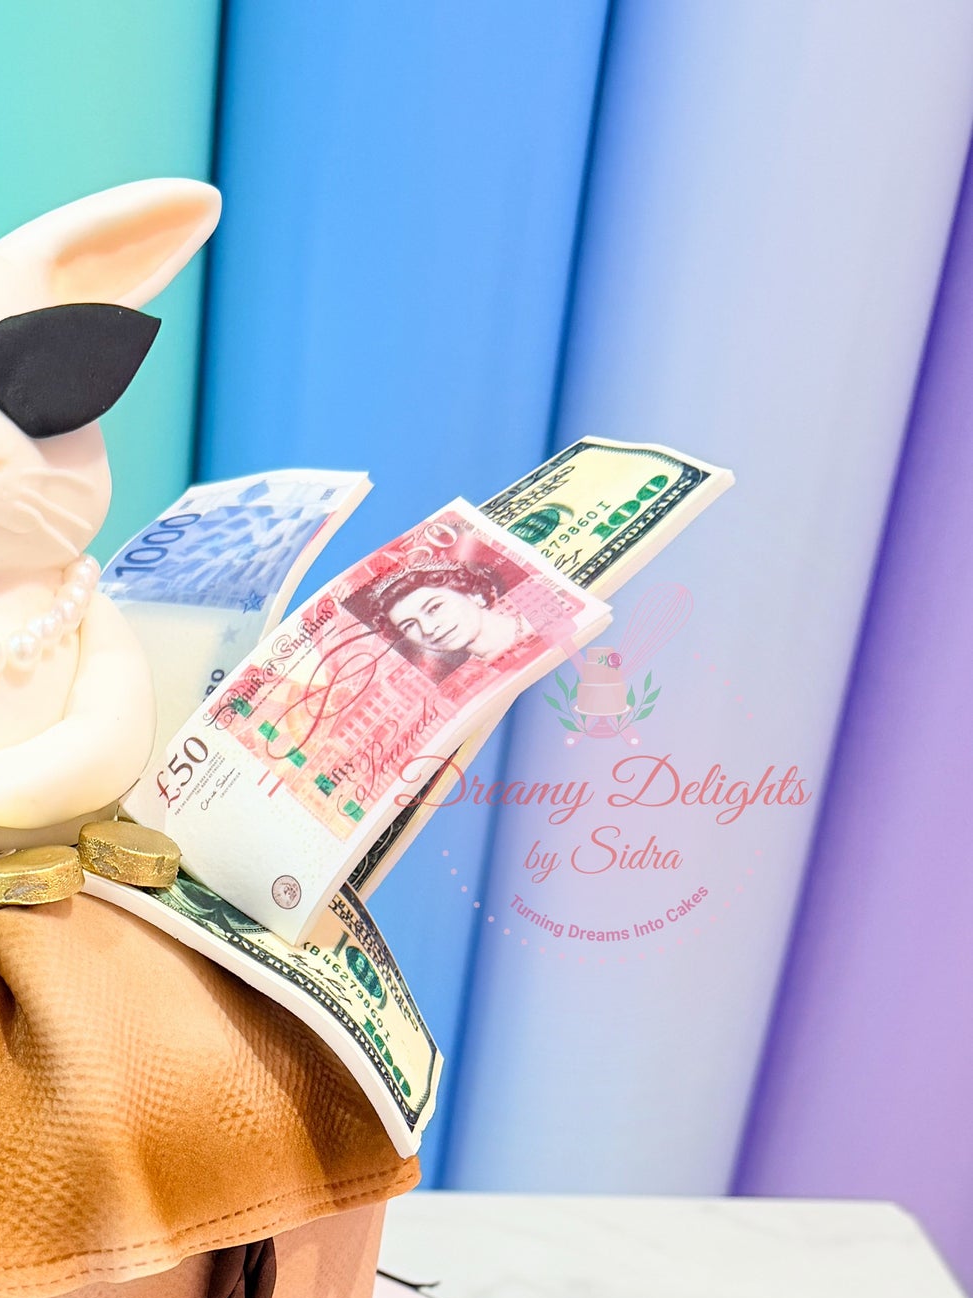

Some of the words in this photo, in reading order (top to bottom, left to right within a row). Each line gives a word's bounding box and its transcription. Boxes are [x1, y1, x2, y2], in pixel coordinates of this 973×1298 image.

[589, 474, 669, 543] 100
[115, 512, 202, 578] 1000
[272, 600, 335, 656] England
[156, 736, 209, 808] £50
[360, 1015, 412, 1098] 100
